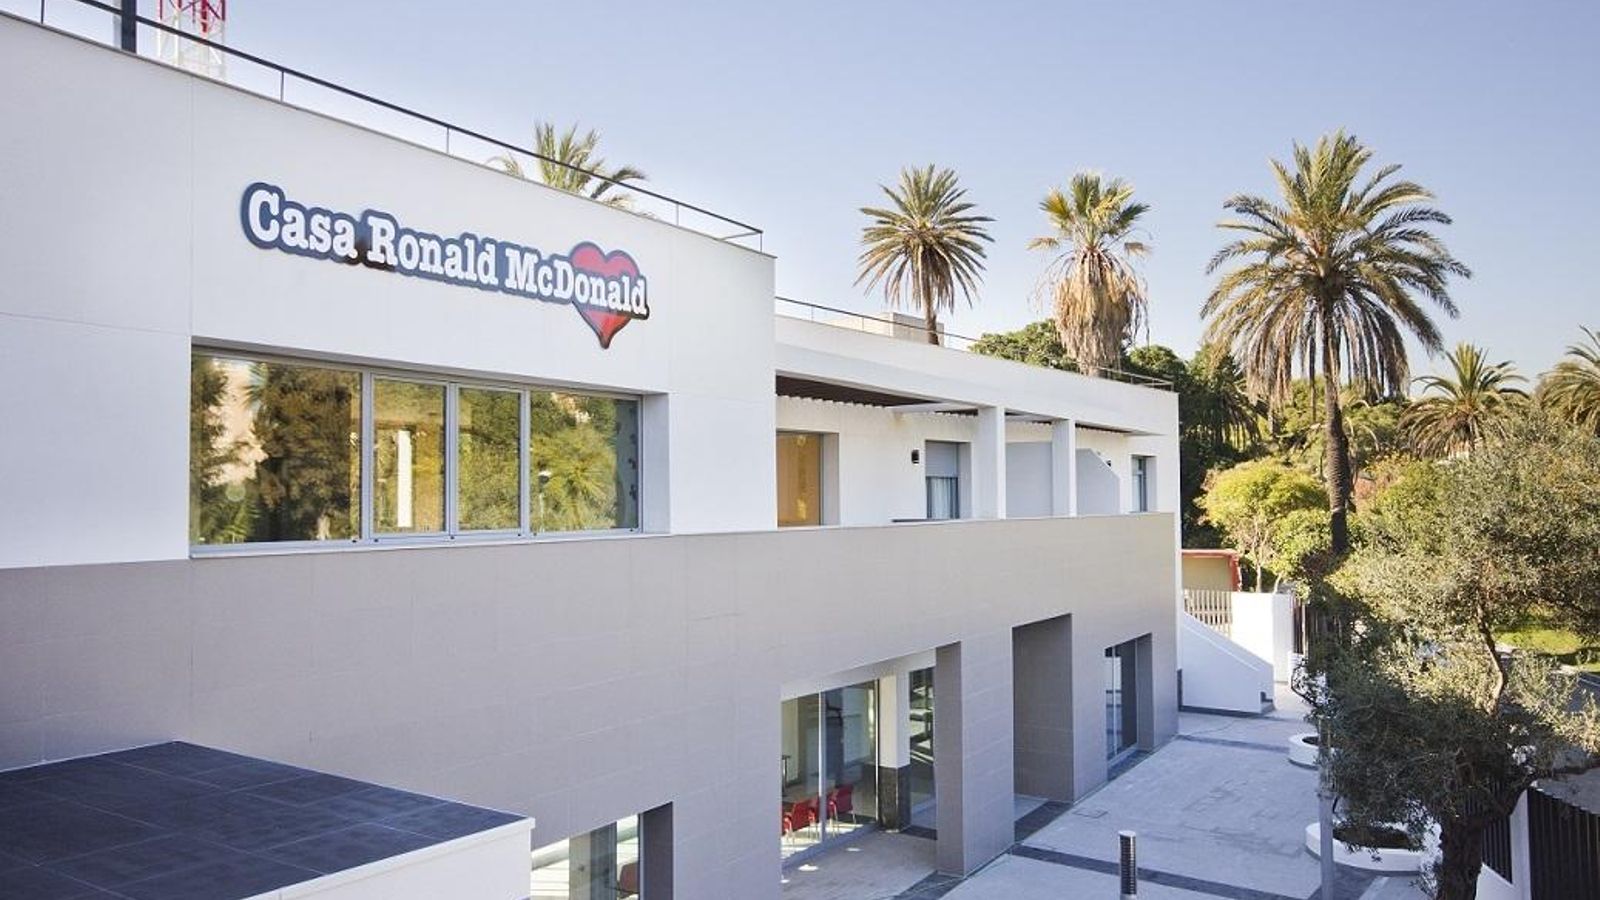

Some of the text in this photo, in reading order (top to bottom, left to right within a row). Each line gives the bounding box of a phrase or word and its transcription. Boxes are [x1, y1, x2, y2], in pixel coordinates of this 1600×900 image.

[248, 189, 647, 315] Casa Ronald McDonald
